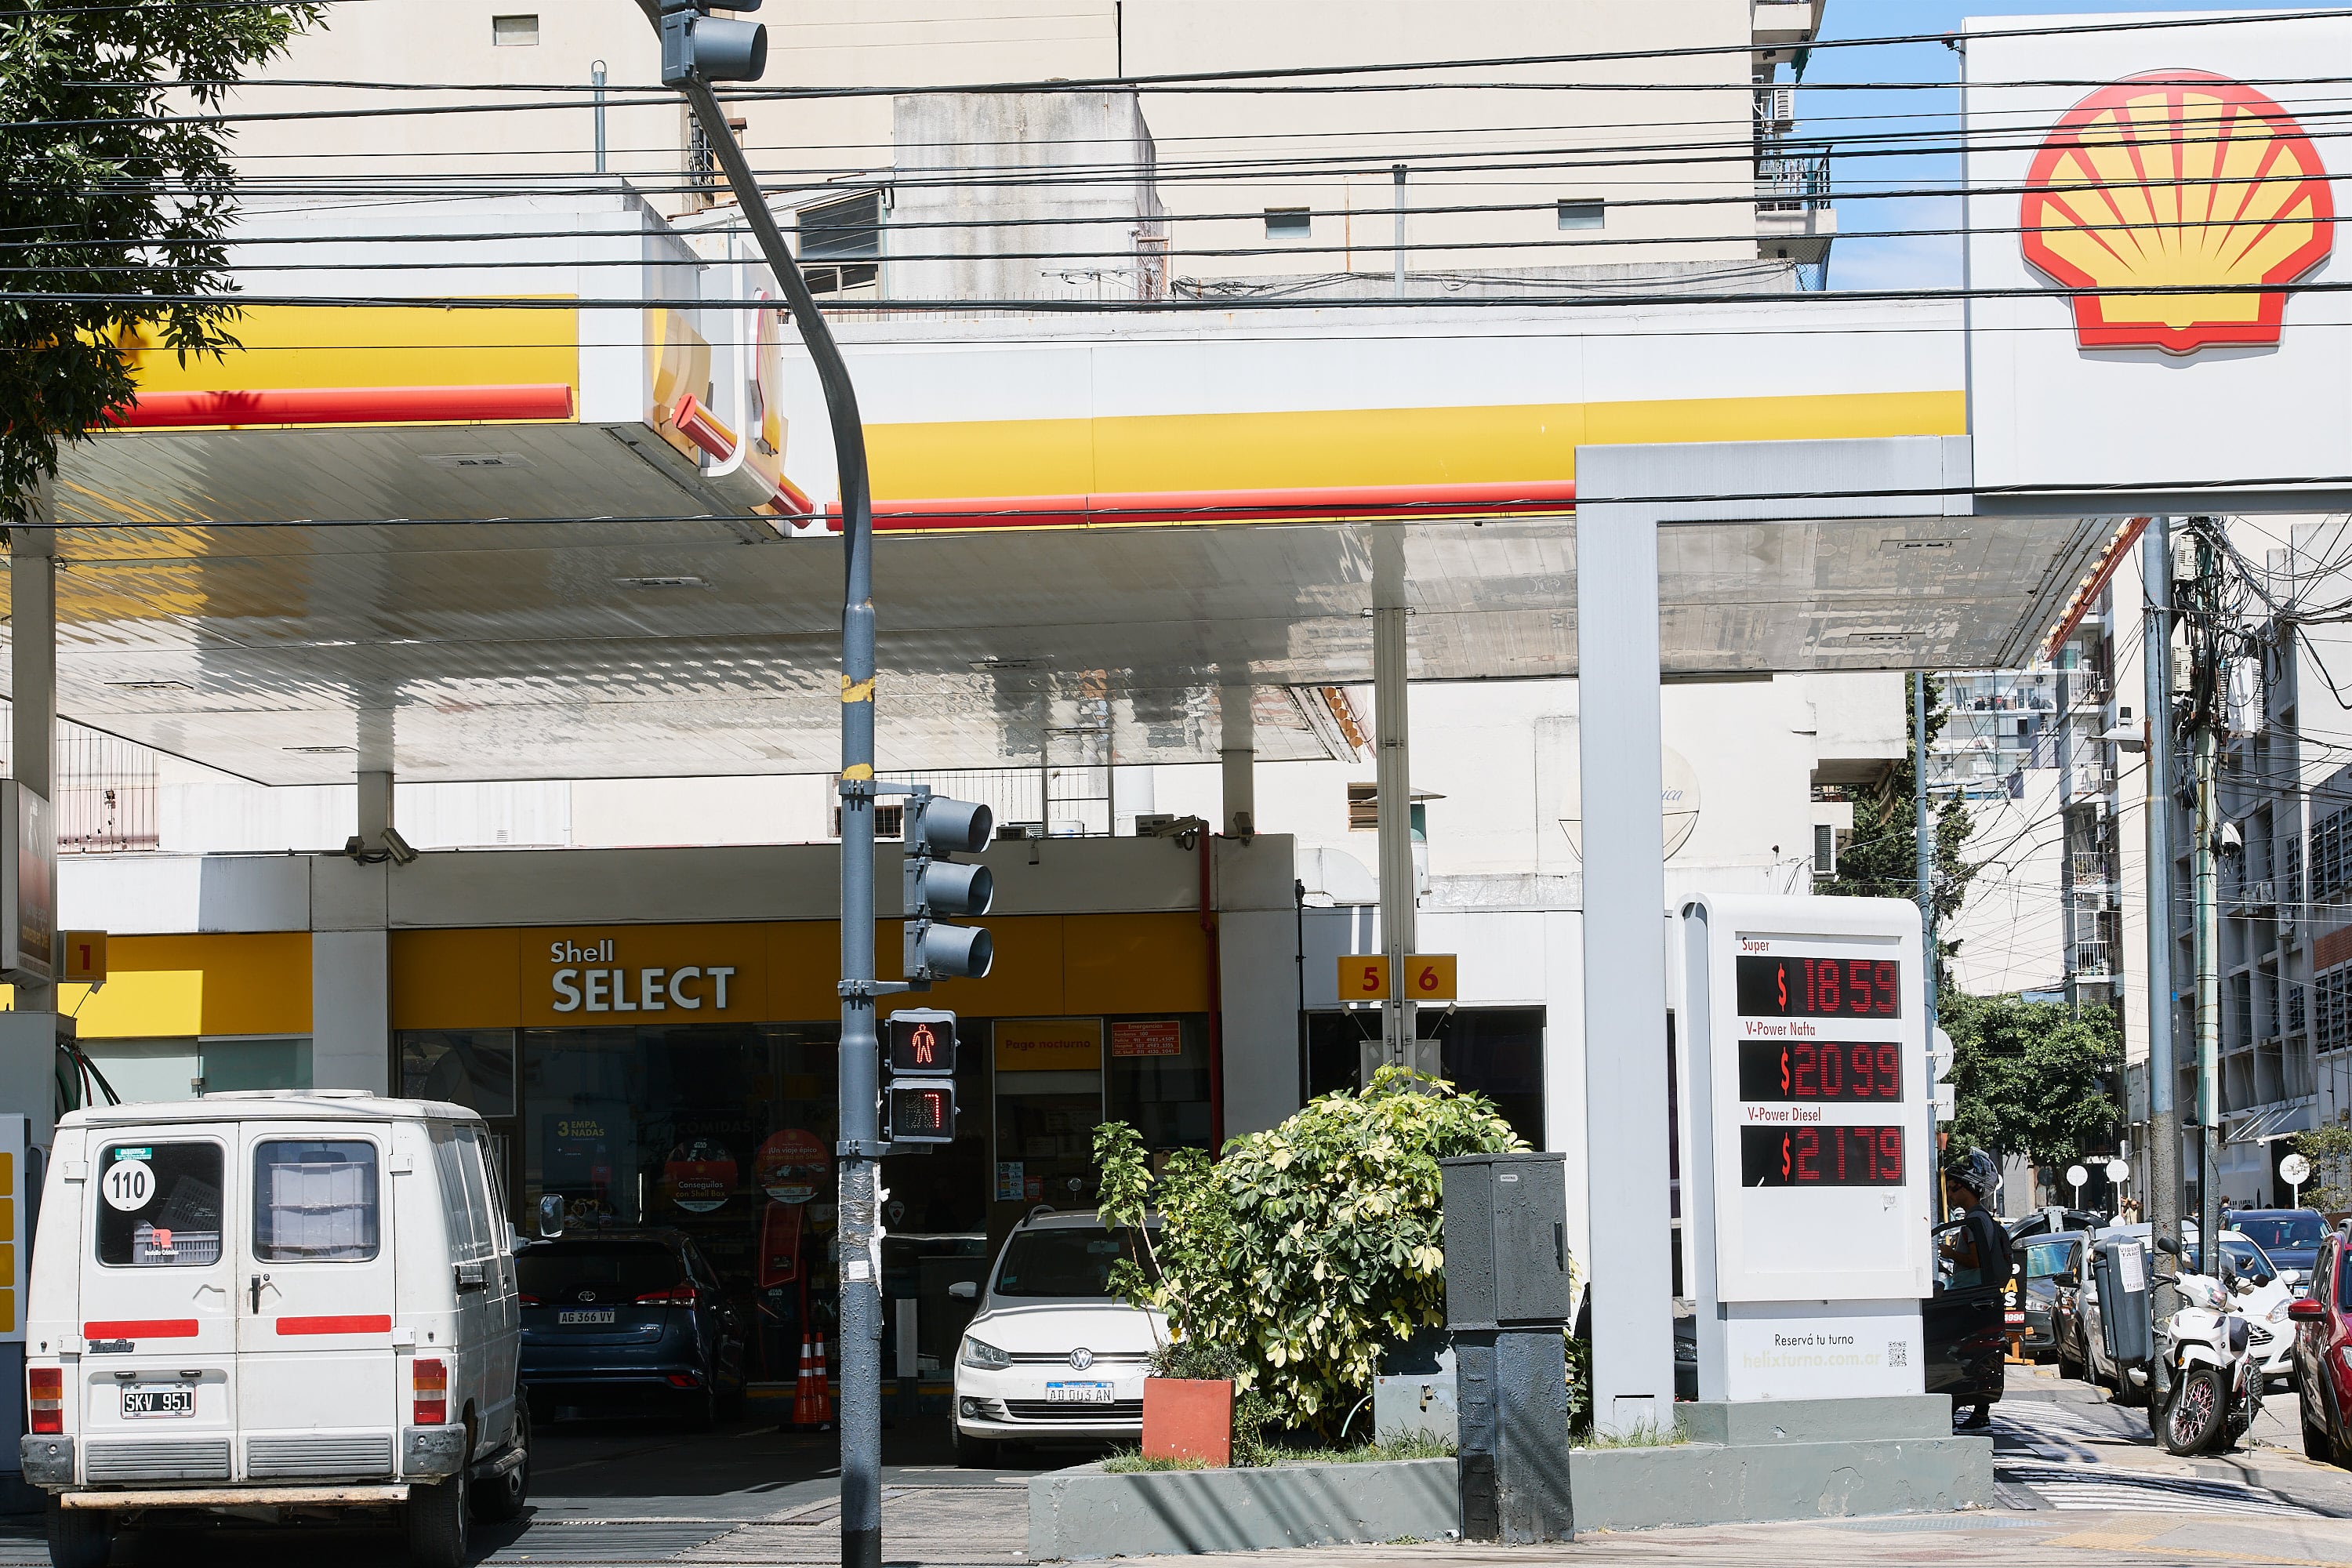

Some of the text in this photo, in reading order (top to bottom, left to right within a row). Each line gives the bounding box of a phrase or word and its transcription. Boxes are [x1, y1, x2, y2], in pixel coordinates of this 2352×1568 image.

[550, 939, 614, 964] Shell
[1741, 936, 1770, 954] Super
[79, 944, 91, 971] 1
[1362, 966, 1380, 992] 5
[1418, 966, 1439, 992] 6
[552, 966, 736, 1012] SELECT
[1745, 1021, 1817, 1037] V-Power Nafta
[1005, 1040, 1091, 1051] Pago nocturno
[1748, 1106, 1821, 1122] V-Power Diesel
[557, 1120, 568, 1137] 3
[571, 1120, 597, 1129] EMPA
[112, 1171, 145, 1199] 110
[678, 1181, 724, 1189] Conseguilos
[561, 1312, 613, 1323] AG 366 VY
[89, 1338, 136, 1354] Trafic
[1774, 1333, 1854, 1347] Reservá tu turno
[162, 1393, 190, 1410] 951
[1096, 1389, 1111, 1401] AN
